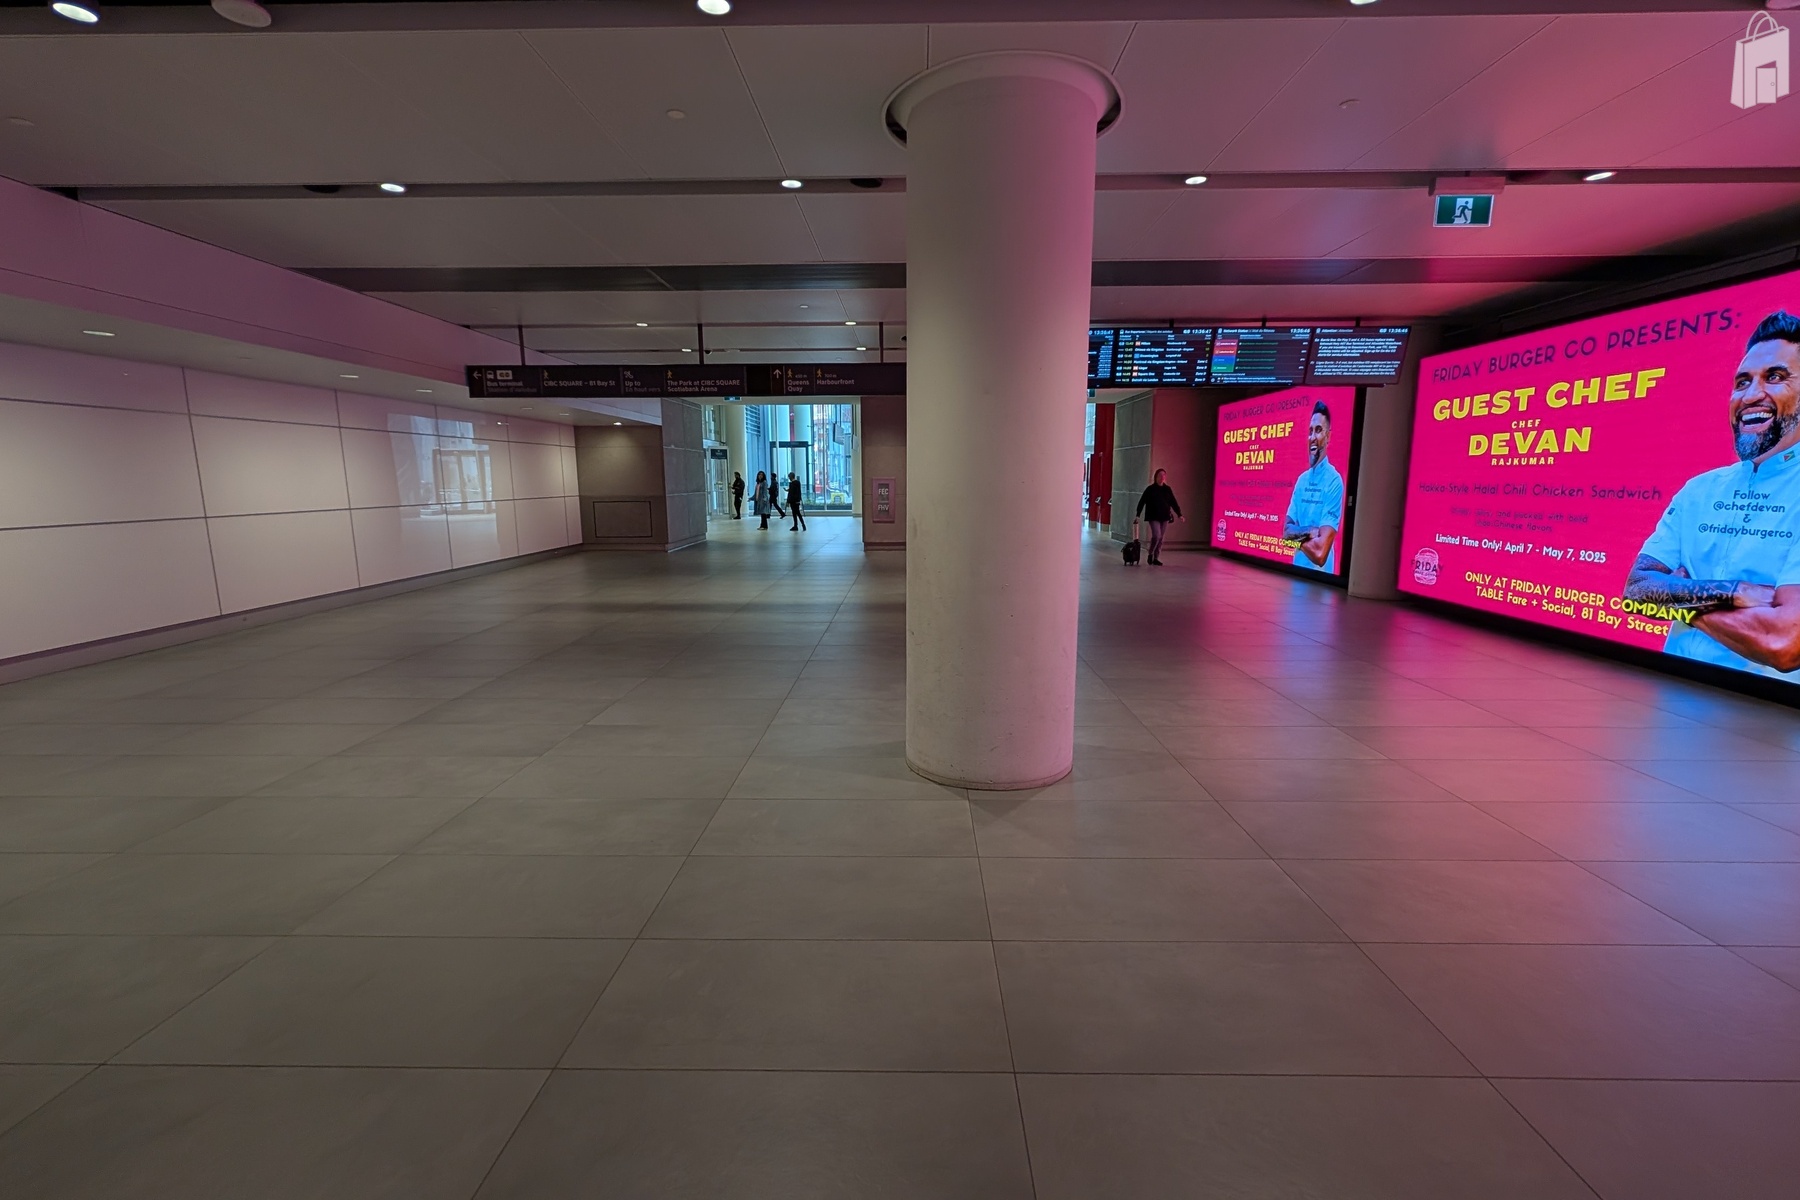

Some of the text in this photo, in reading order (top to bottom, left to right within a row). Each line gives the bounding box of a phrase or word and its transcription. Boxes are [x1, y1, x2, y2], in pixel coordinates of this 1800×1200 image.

[1433, 308, 1742, 383] FRIDAY BURGER CO PRESENTS:
[1433, 367, 1666, 421] GUEST CHEF
[1511, 418, 1542, 429] CHEF
[1224, 422, 1294, 444] GUEST CHEF
[1468, 426, 1592, 456] DEVAN
[1235, 450, 1274, 464] DEVAN
[1491, 456, 1555, 466] RAJKUMAR
[1419, 483, 1662, 500] Hakka-Style Halal Chili Chicken Sandwich
[1732, 490, 1770, 500] Follow
[1713, 500, 1786, 513] @chefdevan
[1548, 512, 1564, 521] with
[1742, 513, 1752, 523] &
[1698, 523, 1793, 540] @fridayburgerco
[1435, 534, 1460, 545] Limited
[1462, 536, 1480, 548] Time
[1482, 538, 1502, 552] Only!
[1504, 542, 1524, 554] April
[1526, 544, 1533, 554] 7
[1542, 546, 1564, 561] May
[1566, 548, 1576, 562] 7,
[1579, 549, 1606, 564] 2025
[1465, 571, 1696, 624] ONLY AT FRIDAY BURGER COMPANY
[1476, 586, 1668, 636] TABLE Fare + Social, 81 Bay Street
